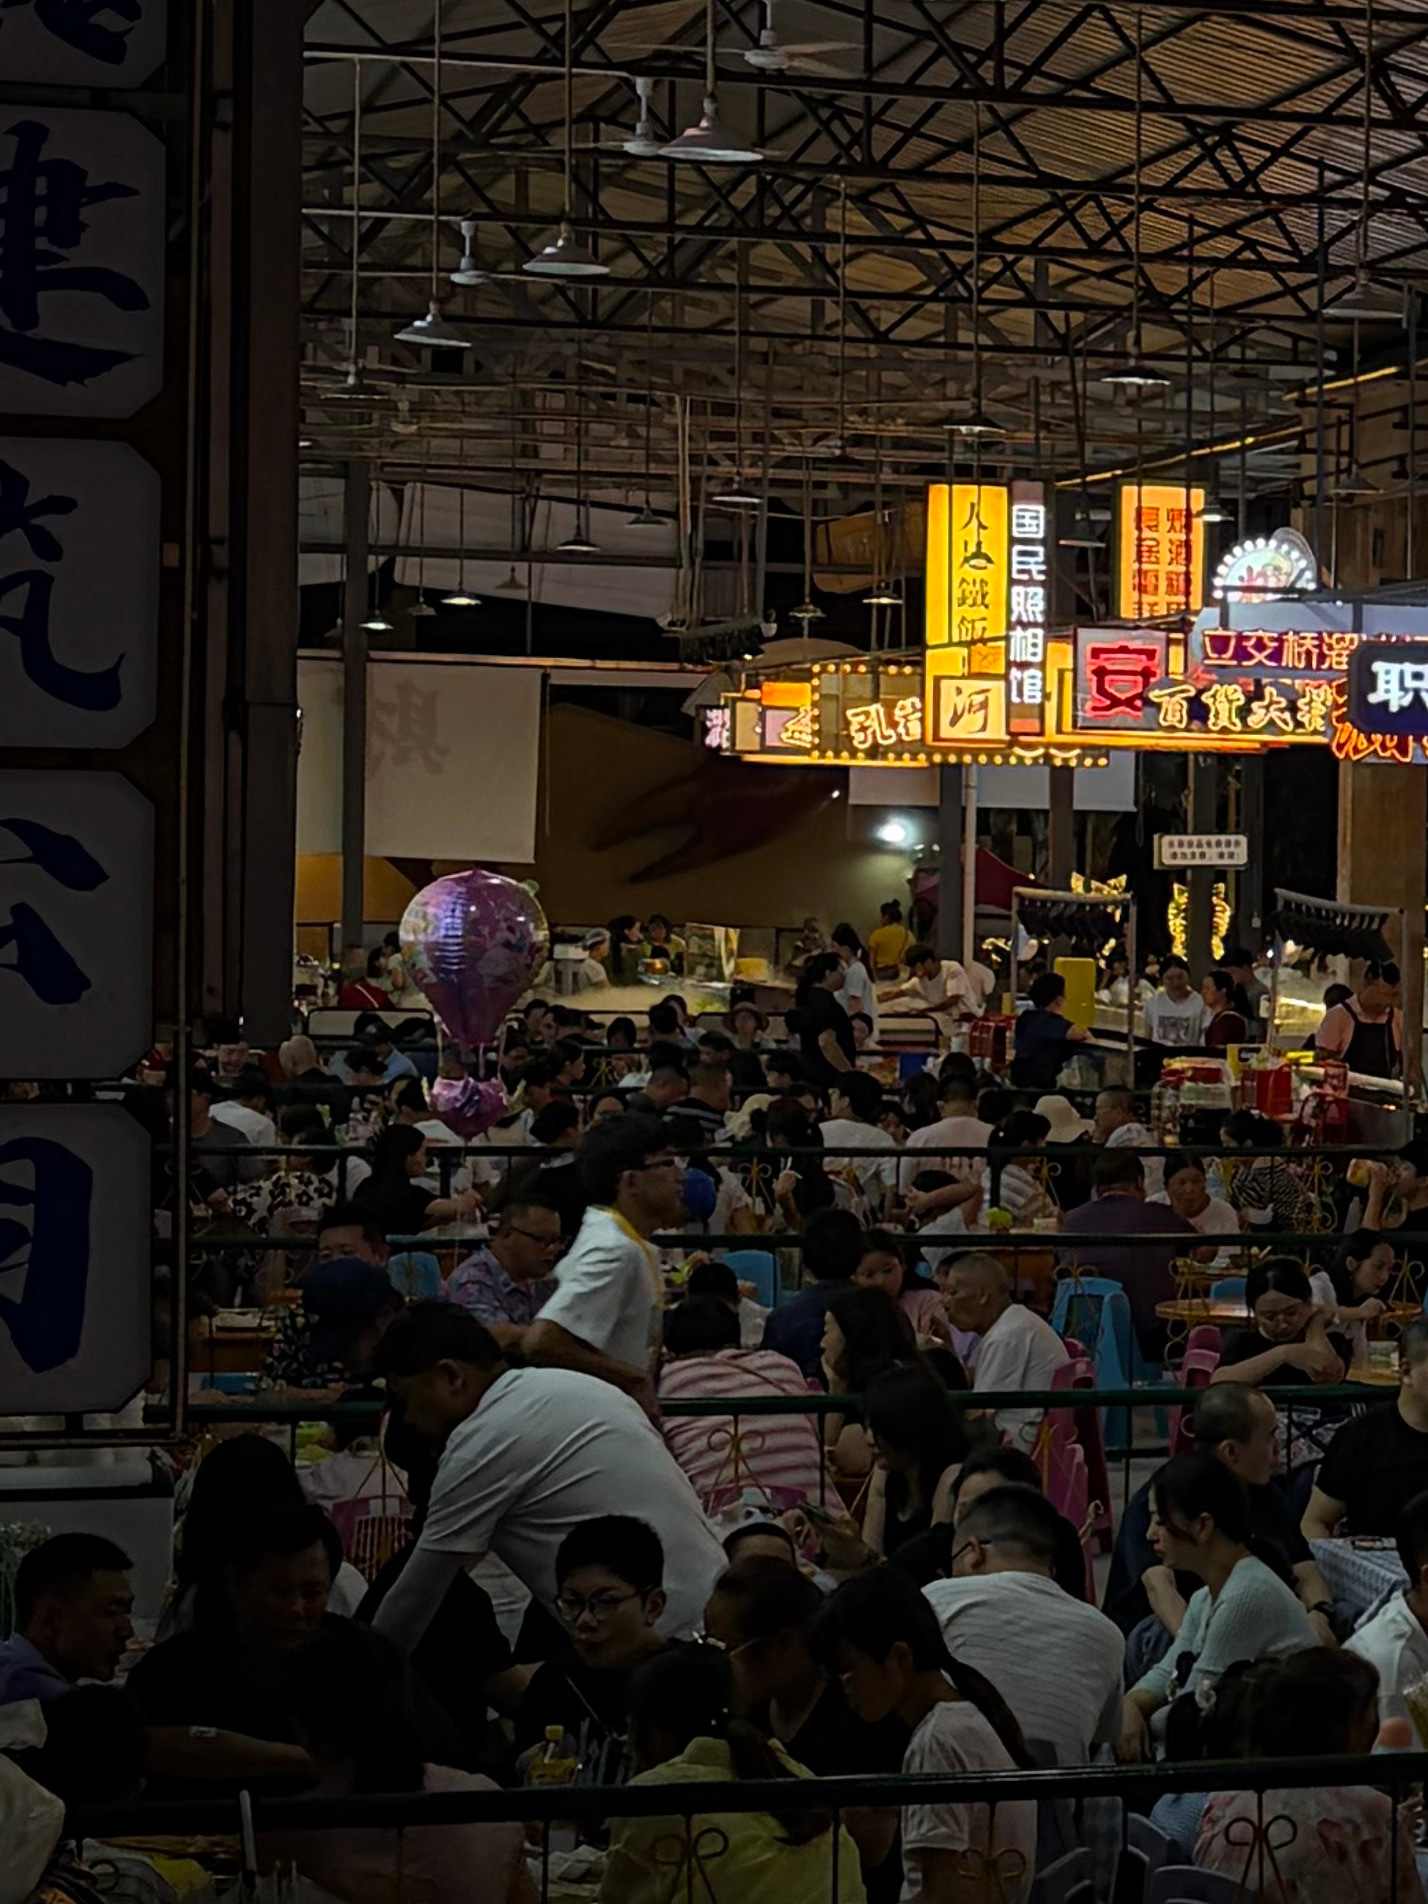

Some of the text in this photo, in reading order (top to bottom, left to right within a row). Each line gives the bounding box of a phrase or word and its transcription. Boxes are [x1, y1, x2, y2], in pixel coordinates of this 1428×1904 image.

[958, 501, 995, 647] 人鐵飯
[1010, 504, 1047, 704] 国民照相馆
